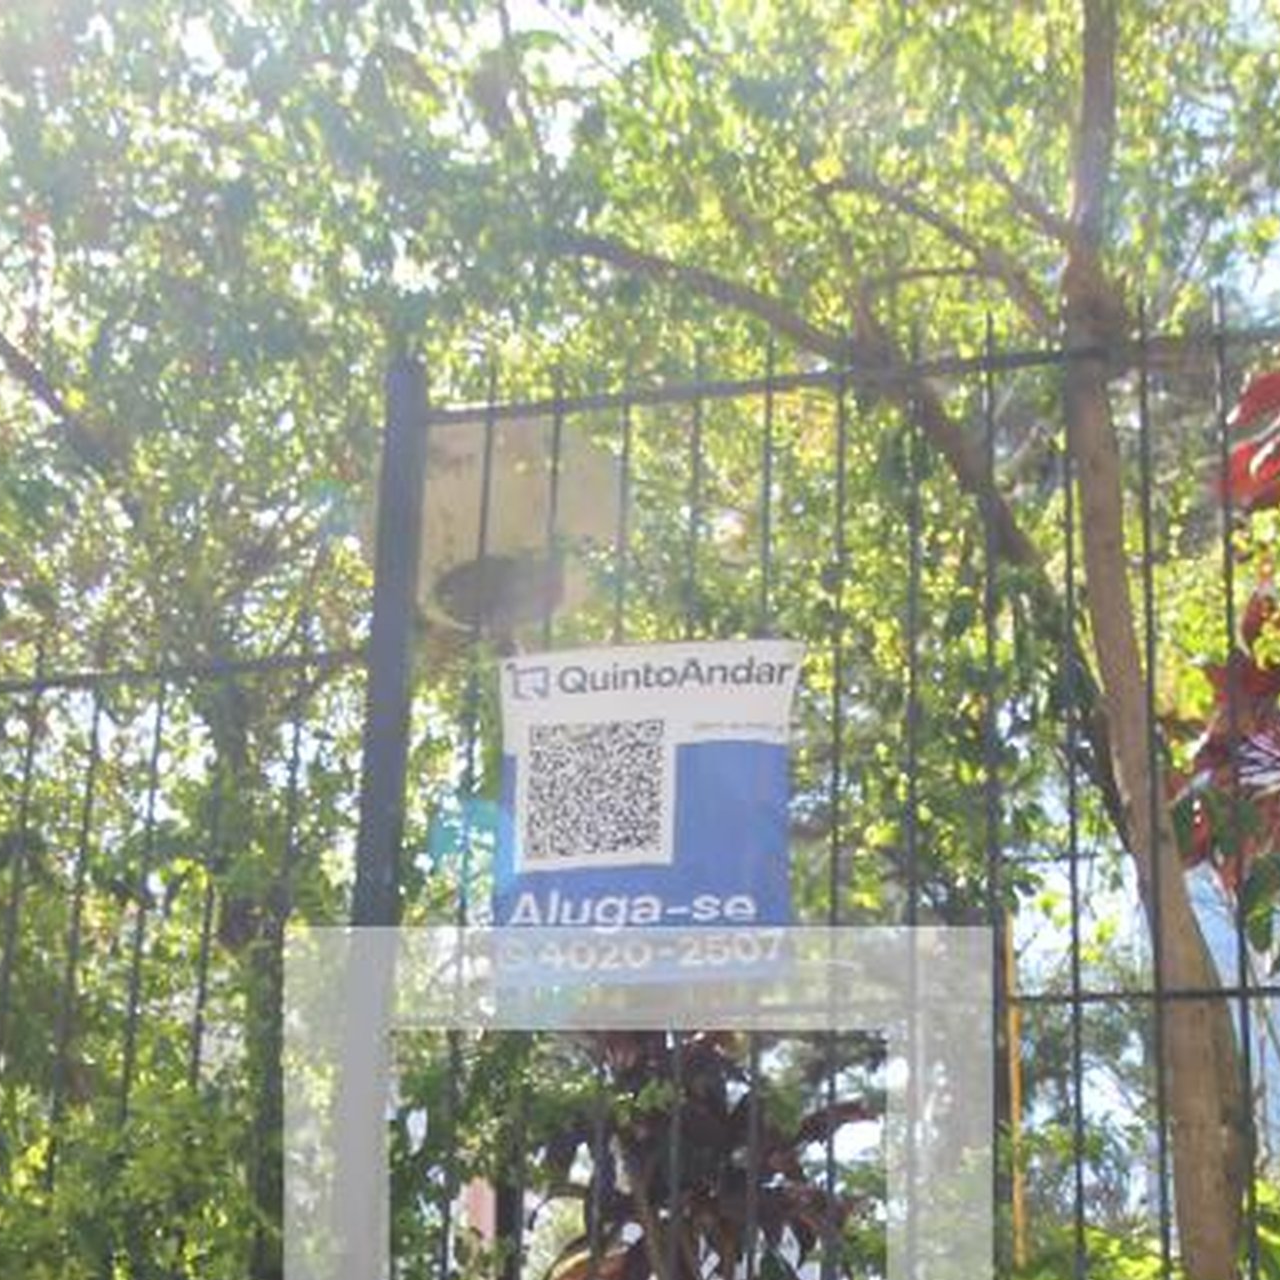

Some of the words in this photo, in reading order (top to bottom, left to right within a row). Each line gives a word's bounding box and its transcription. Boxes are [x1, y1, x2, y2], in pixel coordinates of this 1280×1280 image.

[558, 657, 794, 695] QuintoAndar
[510, 892, 758, 933] Aluga-se
[537, 928, 785, 971] 4020-2507
